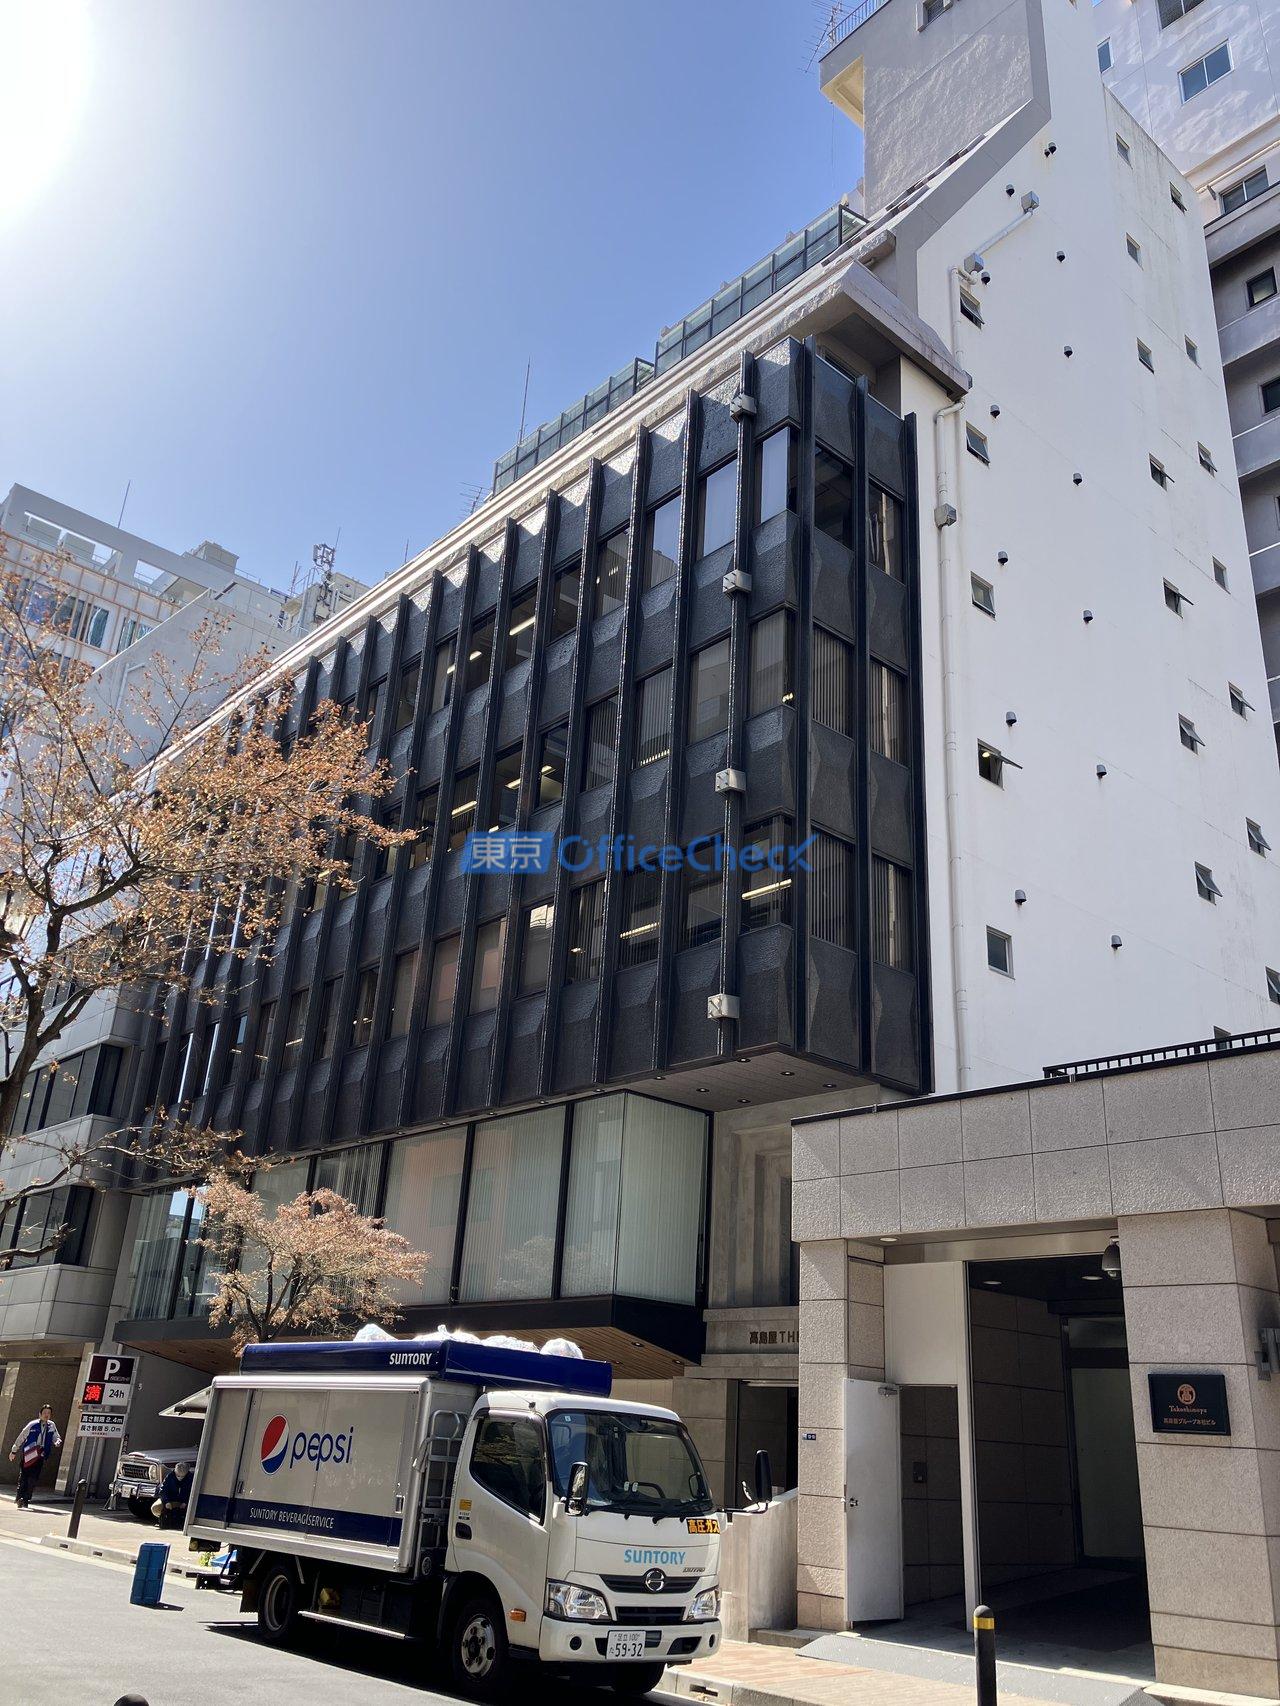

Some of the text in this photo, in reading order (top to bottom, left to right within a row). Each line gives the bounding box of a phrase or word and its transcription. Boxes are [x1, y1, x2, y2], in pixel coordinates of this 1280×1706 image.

[389, 1352, 432, 1365] SUNTORY
[104, 1359, 120, 1380] P
[109, 1389, 125, 1398] 24h
[289, 1426, 354, 1471] pepsi
[250, 1507, 278, 1520] SUNTORY
[308, 1515, 334, 1529] SERVICE
[687, 1519, 720, 1534] 高圧ガス
[623, 1549, 686, 1565] SUNTORY
